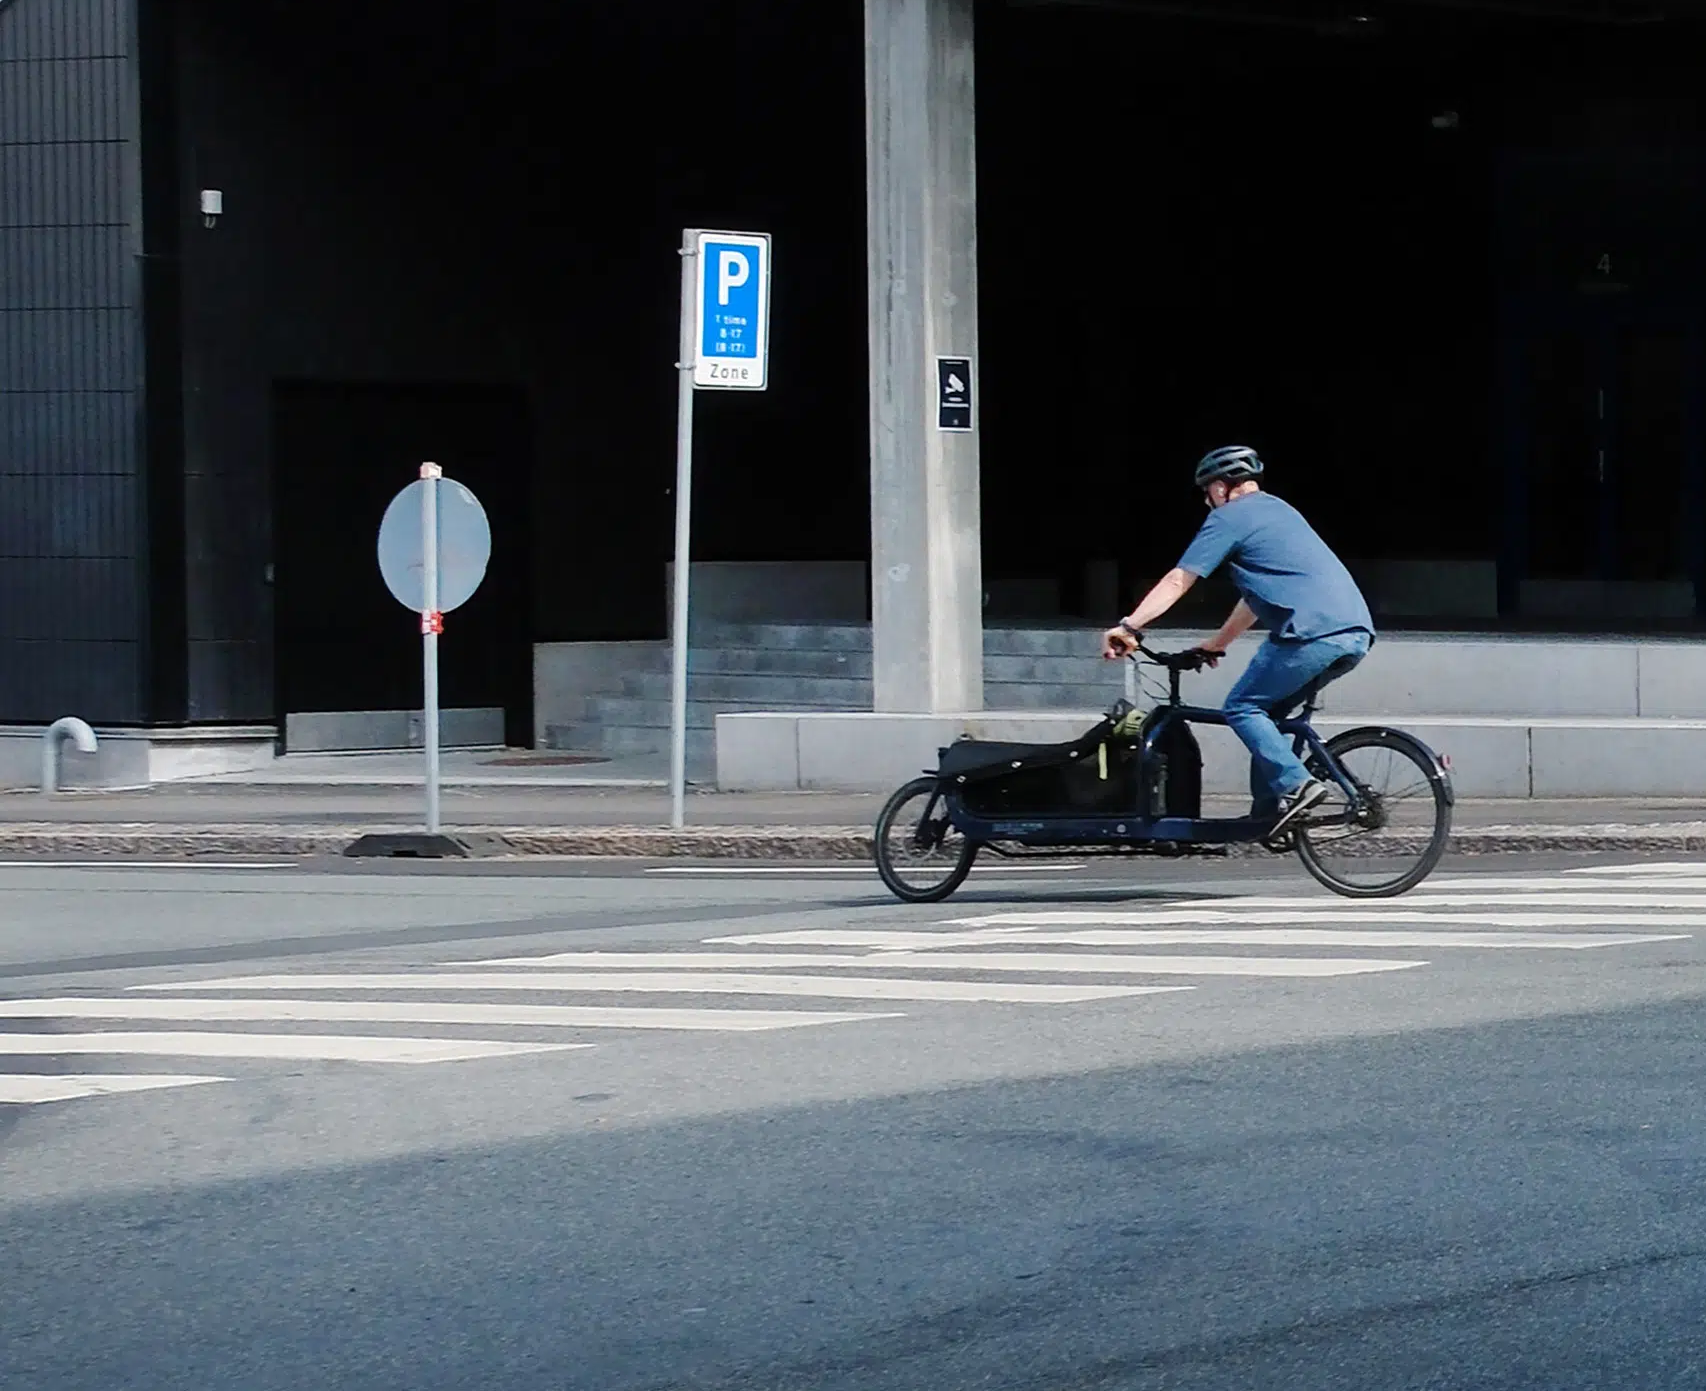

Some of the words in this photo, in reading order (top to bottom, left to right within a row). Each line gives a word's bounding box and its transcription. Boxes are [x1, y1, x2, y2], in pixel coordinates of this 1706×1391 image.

[1597, 253, 1610, 274] 4
[718, 250, 750, 306] P
[710, 363, 749, 380] Zone
